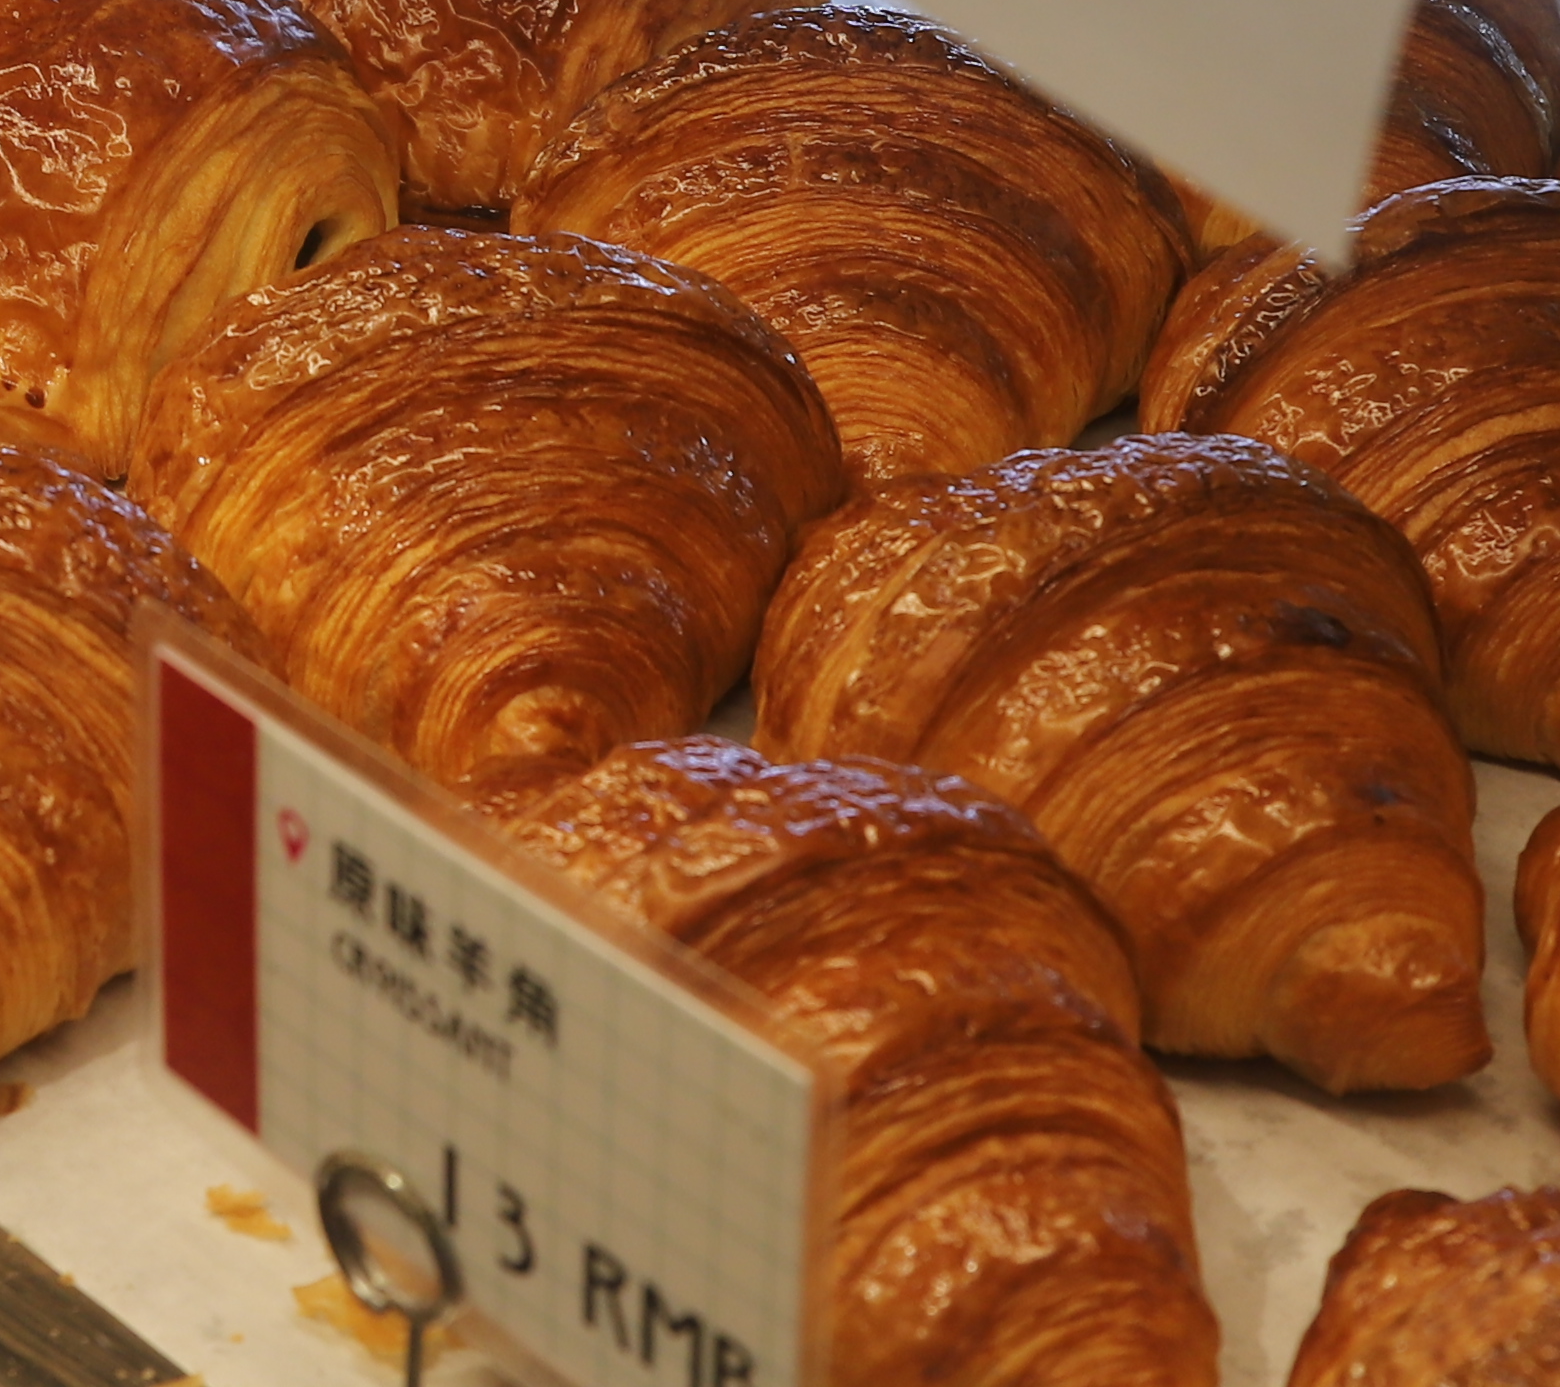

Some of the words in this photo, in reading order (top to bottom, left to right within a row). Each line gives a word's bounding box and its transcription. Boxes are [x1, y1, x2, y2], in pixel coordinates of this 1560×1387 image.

[329, 838, 561, 1051] 原味羊角
[442, 1144, 535, 1275] 13
